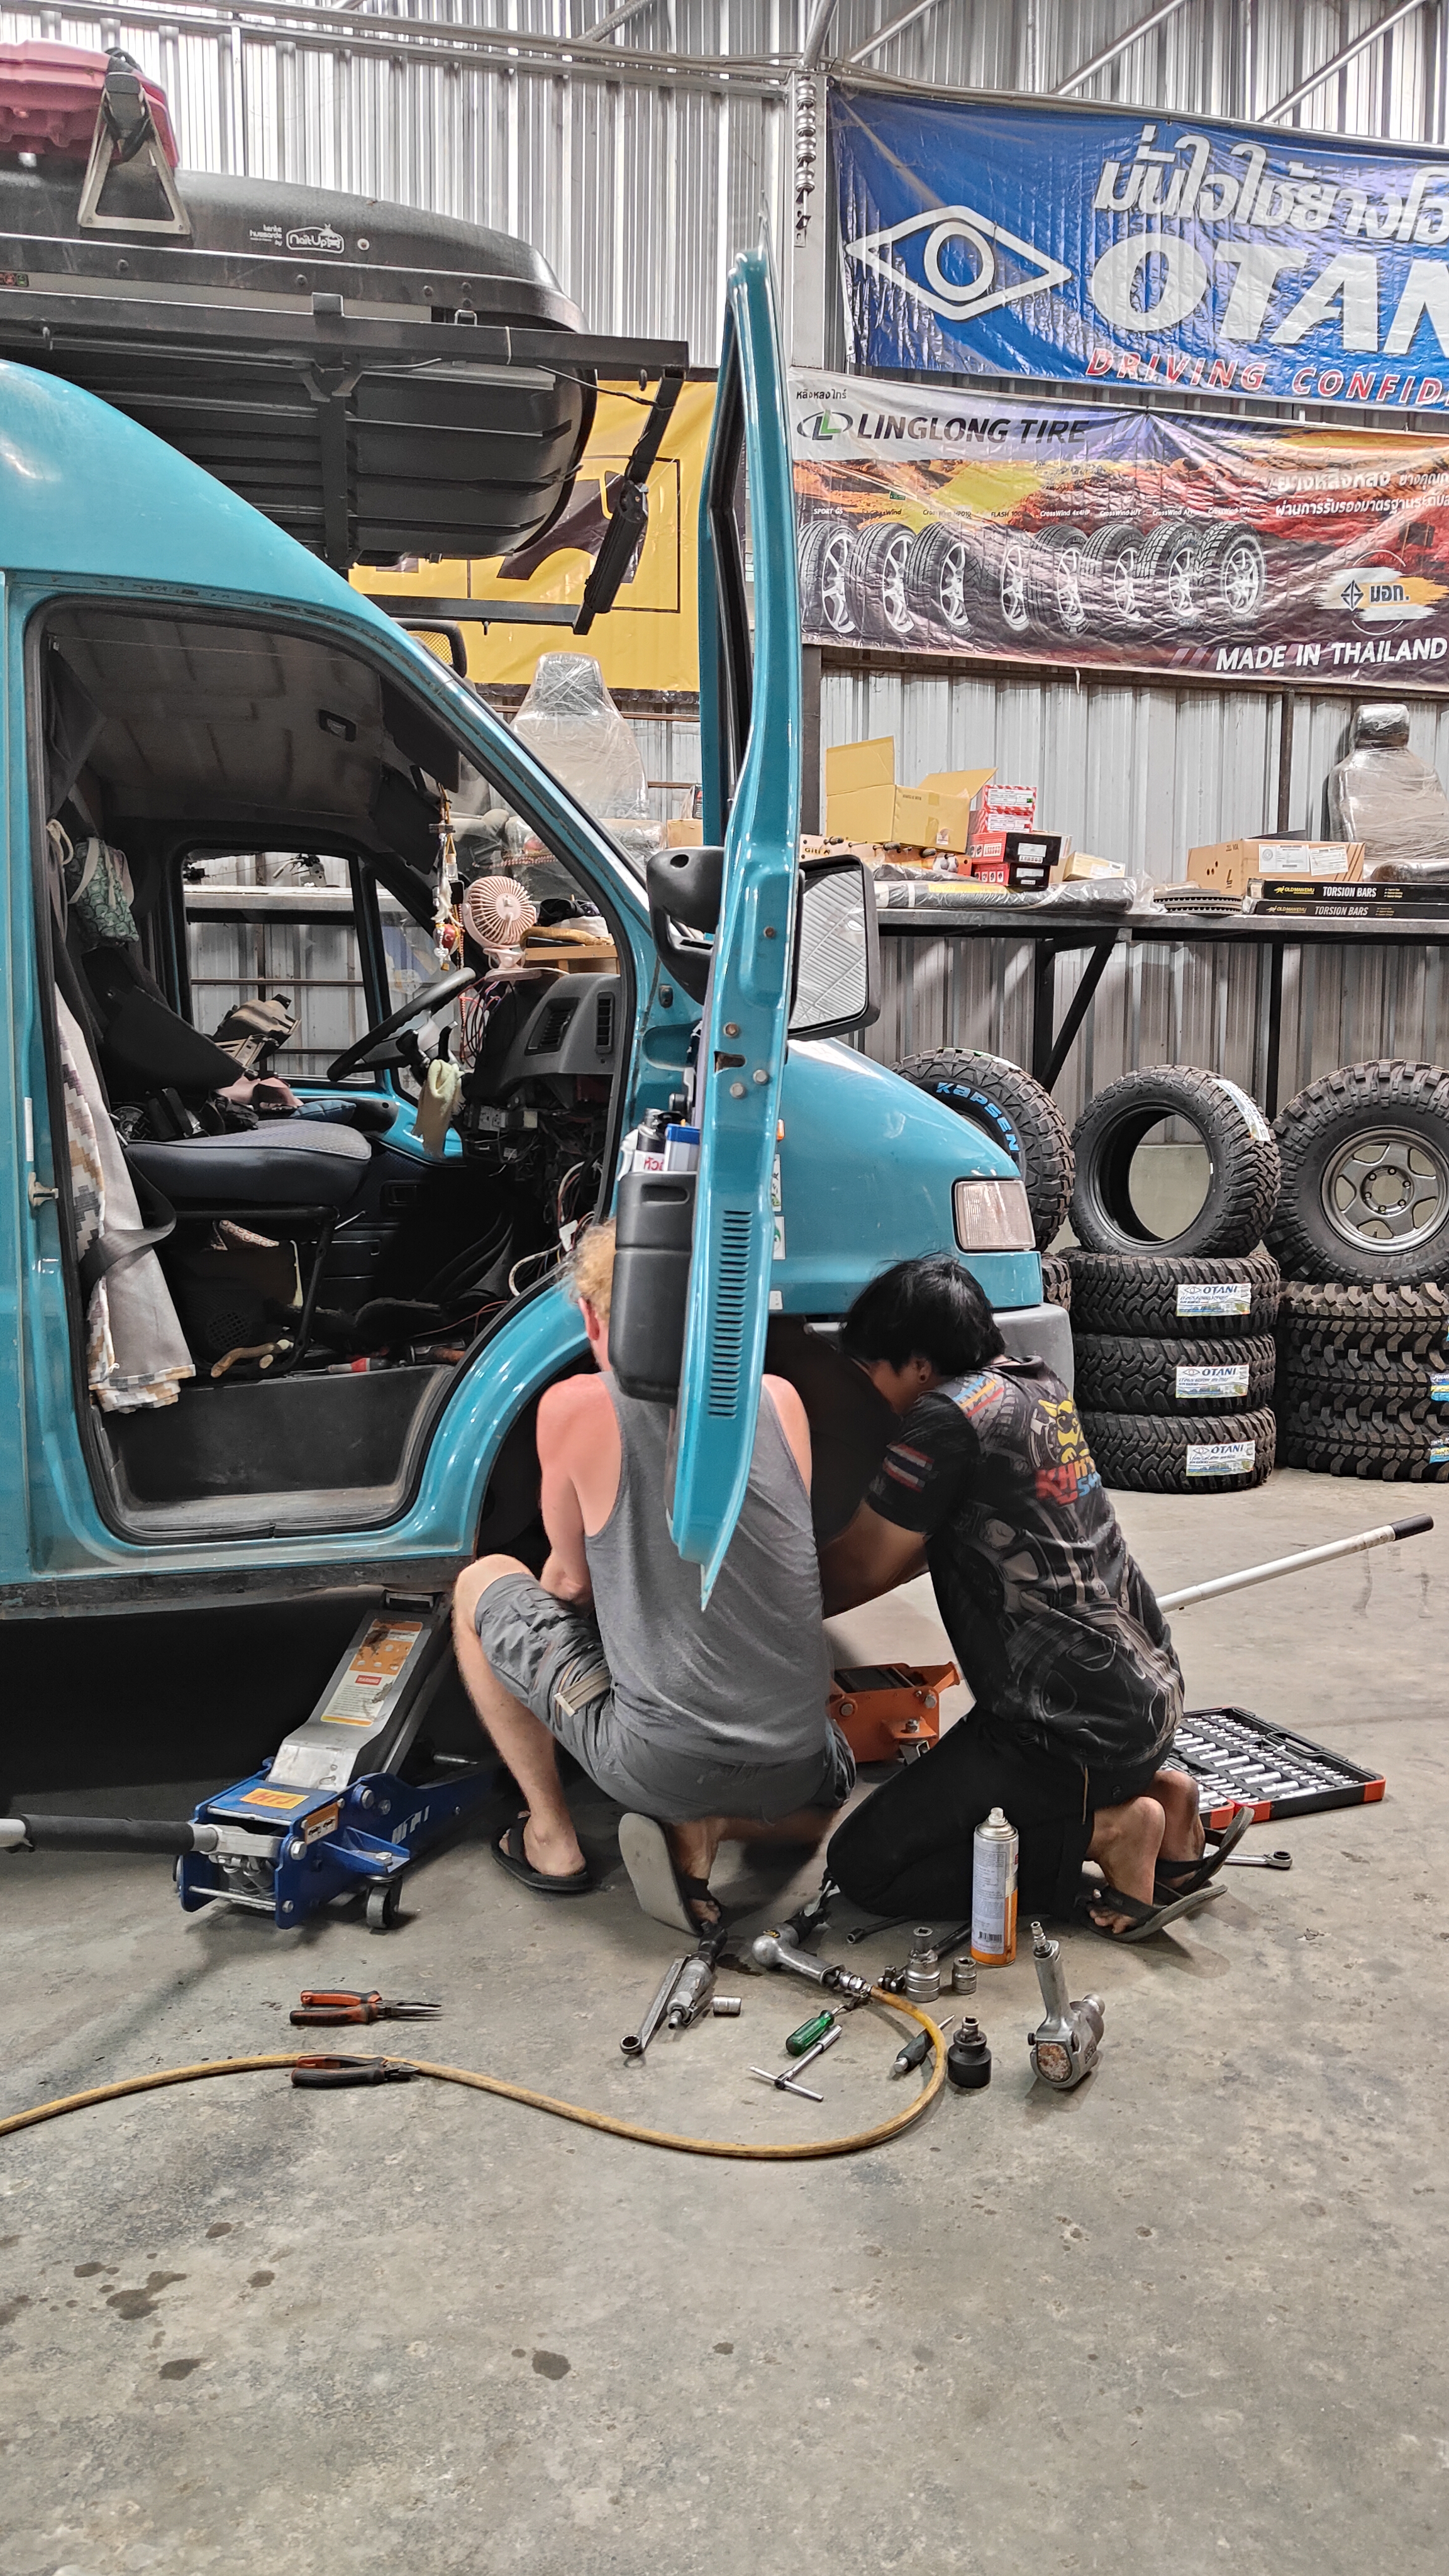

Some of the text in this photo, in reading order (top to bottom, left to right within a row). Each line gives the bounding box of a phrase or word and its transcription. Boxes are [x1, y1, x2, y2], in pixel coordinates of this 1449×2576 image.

[1085, 348, 1449, 406] DRIVING CONFID
[857, 413, 1090, 444] LINGLONG TIRE
[1216, 637, 1448, 671] MADE IN THAILAND
[1323, 886, 1355, 897] TORSION
[1357, 887, 1377, 898] BARS
[1314, 906, 1348, 916] TORSION
[1348, 906, 1369, 916] BARS
[1202, 1285, 1238, 1294] OTANI
[1201, 1367, 1236, 1376] OTANI
[1210, 1444, 1244, 1454] OTANI
